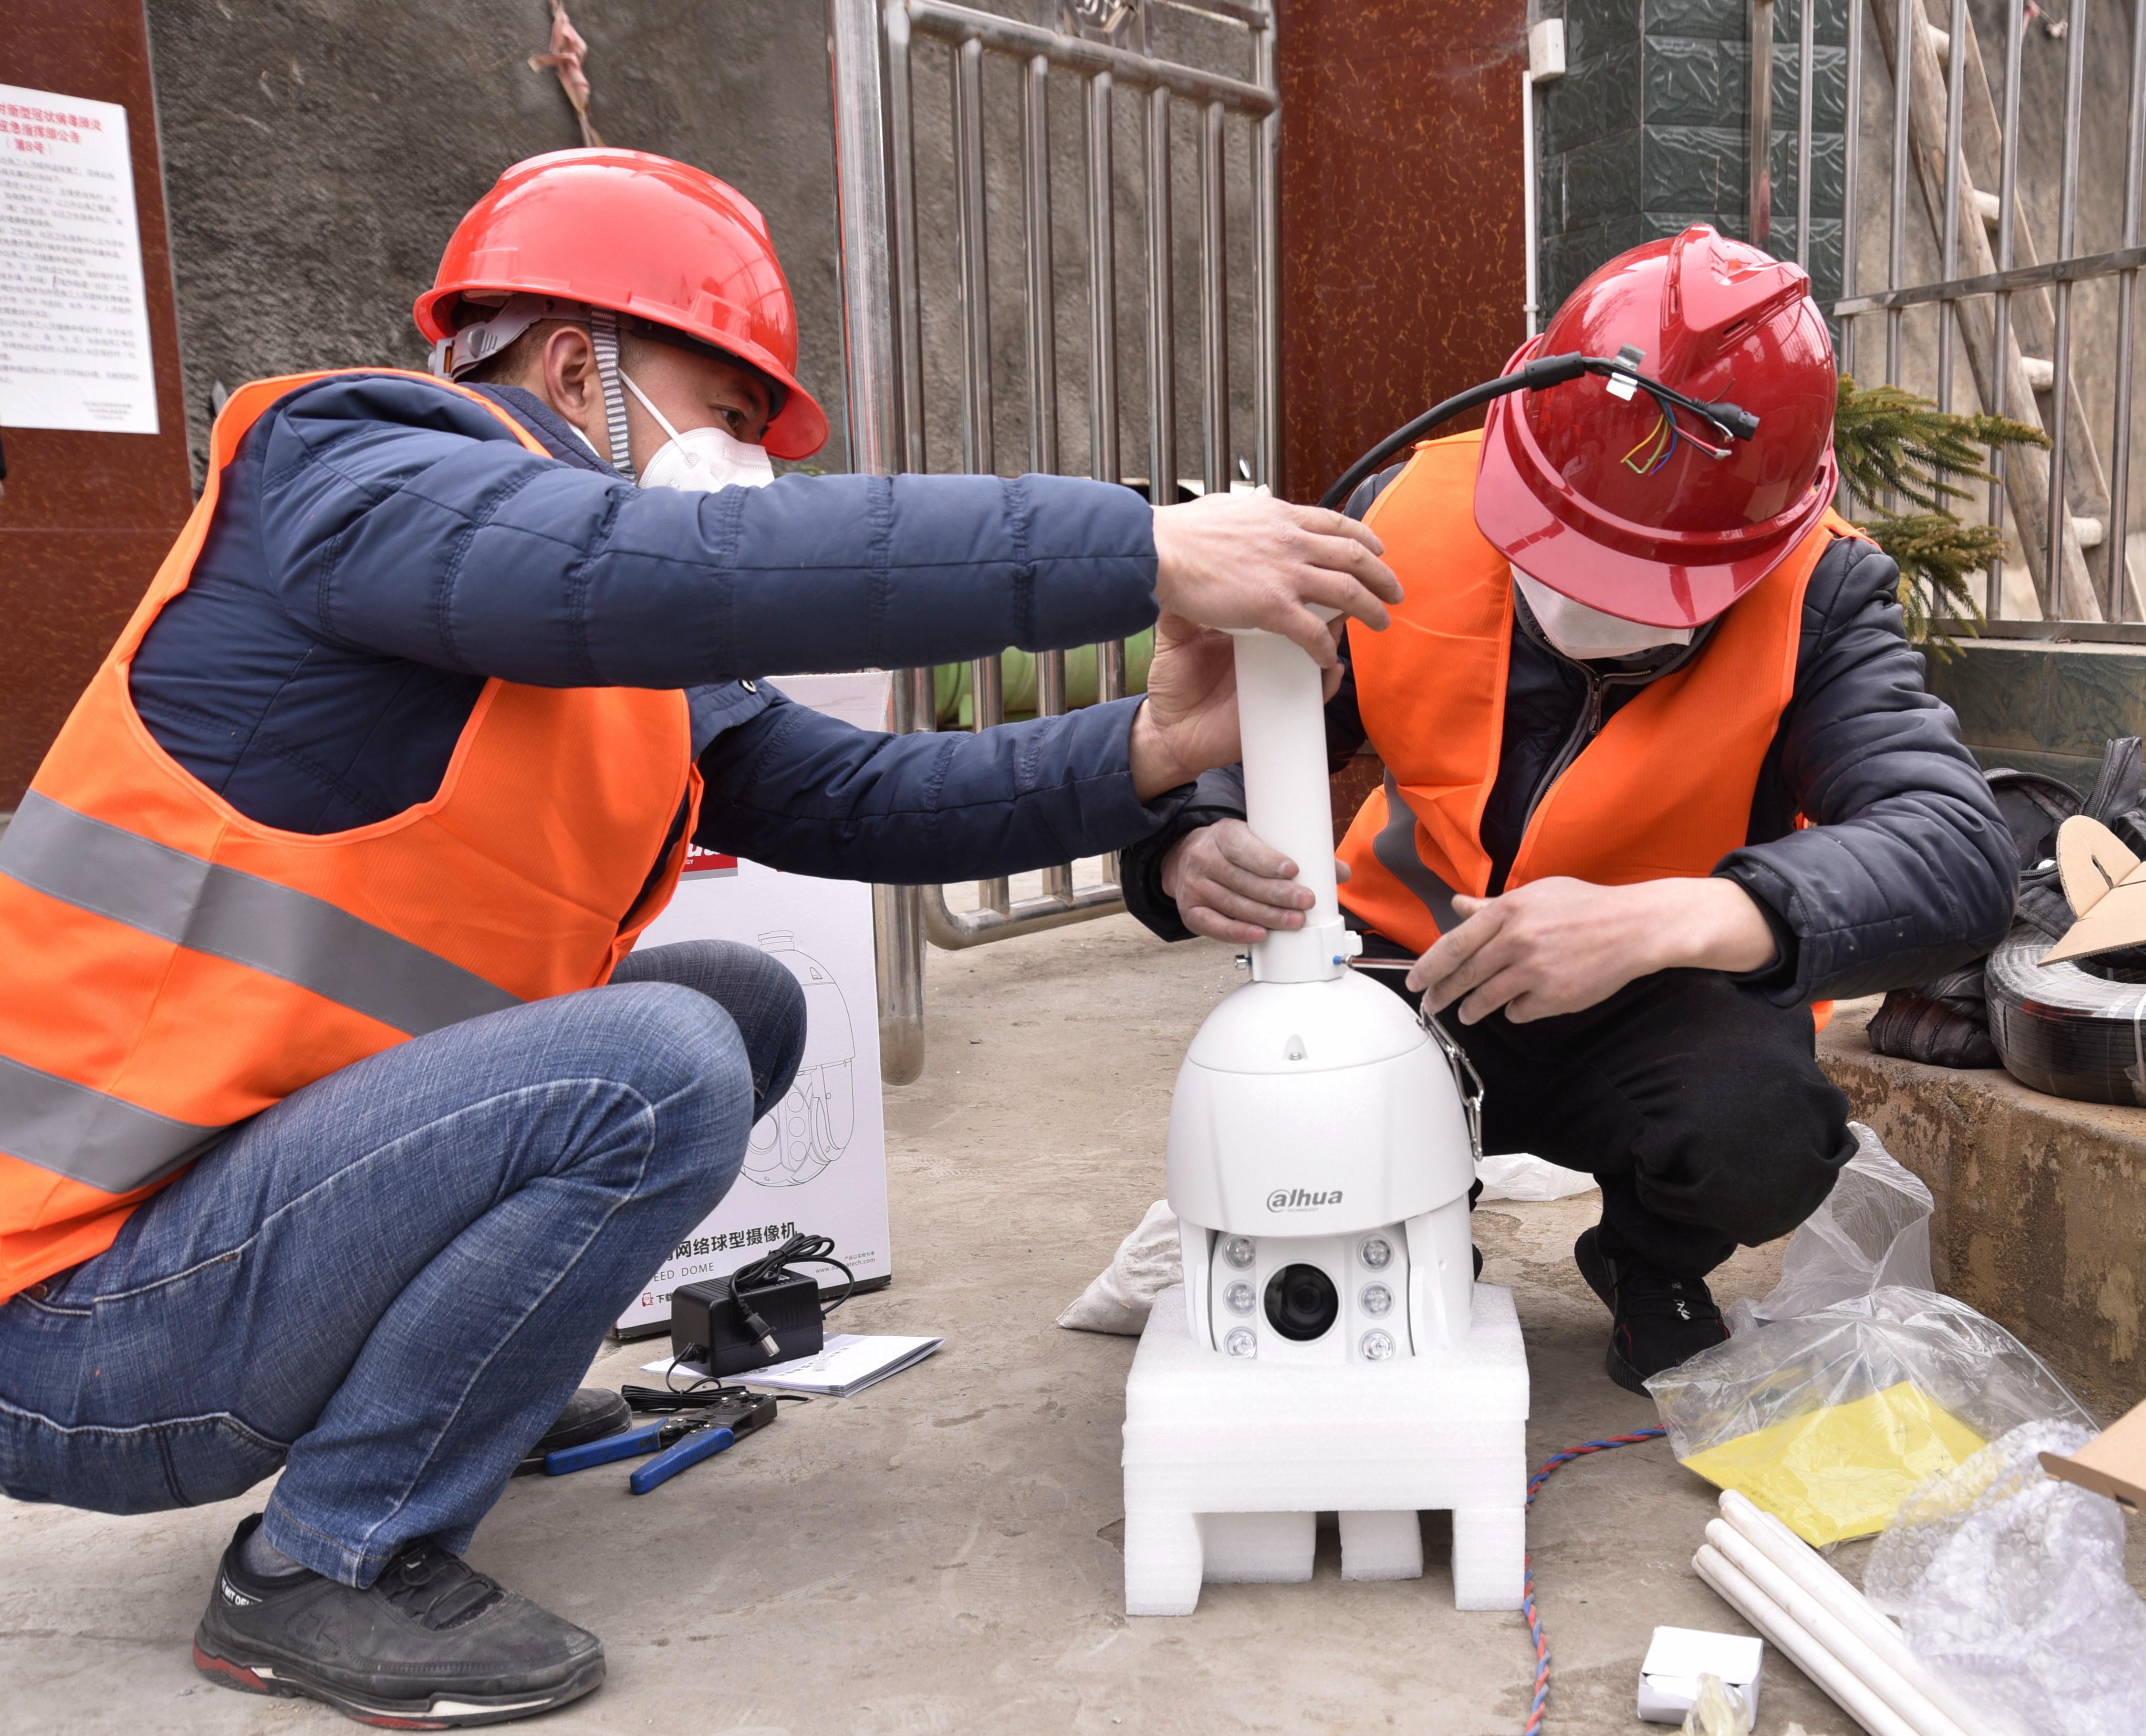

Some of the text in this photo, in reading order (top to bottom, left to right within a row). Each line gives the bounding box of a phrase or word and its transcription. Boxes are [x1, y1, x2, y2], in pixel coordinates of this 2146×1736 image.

[844, 1251, 875, 1260] 产品以实物为准
[654, 1262, 714, 1282] EED DOME
[815, 1258, 876, 1274] www.daatech.com
